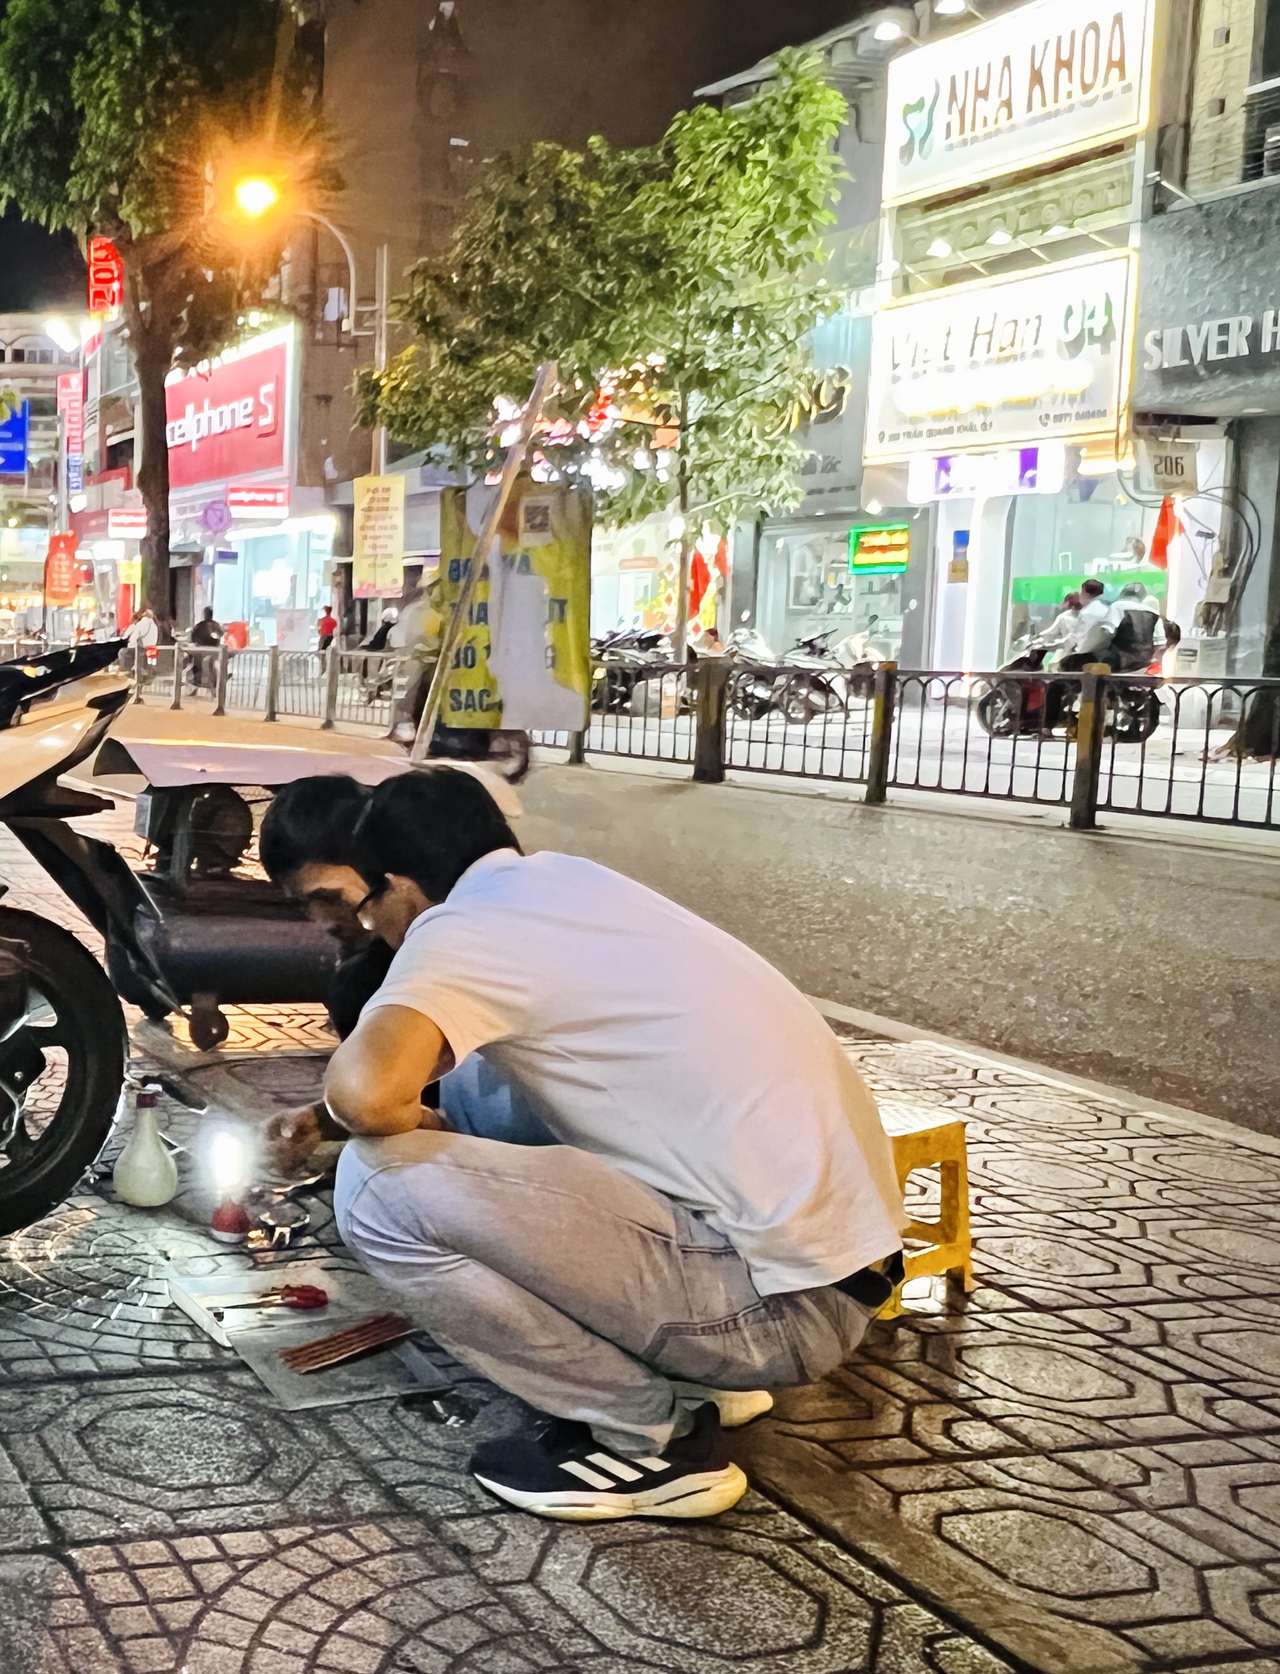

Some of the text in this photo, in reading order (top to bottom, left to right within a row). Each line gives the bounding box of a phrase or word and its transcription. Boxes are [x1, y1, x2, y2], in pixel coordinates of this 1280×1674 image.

[1026, 12, 1126, 113] KHOA
[1143, 314, 1253, 371] SILVER
[1154, 455, 1184, 476] 206
